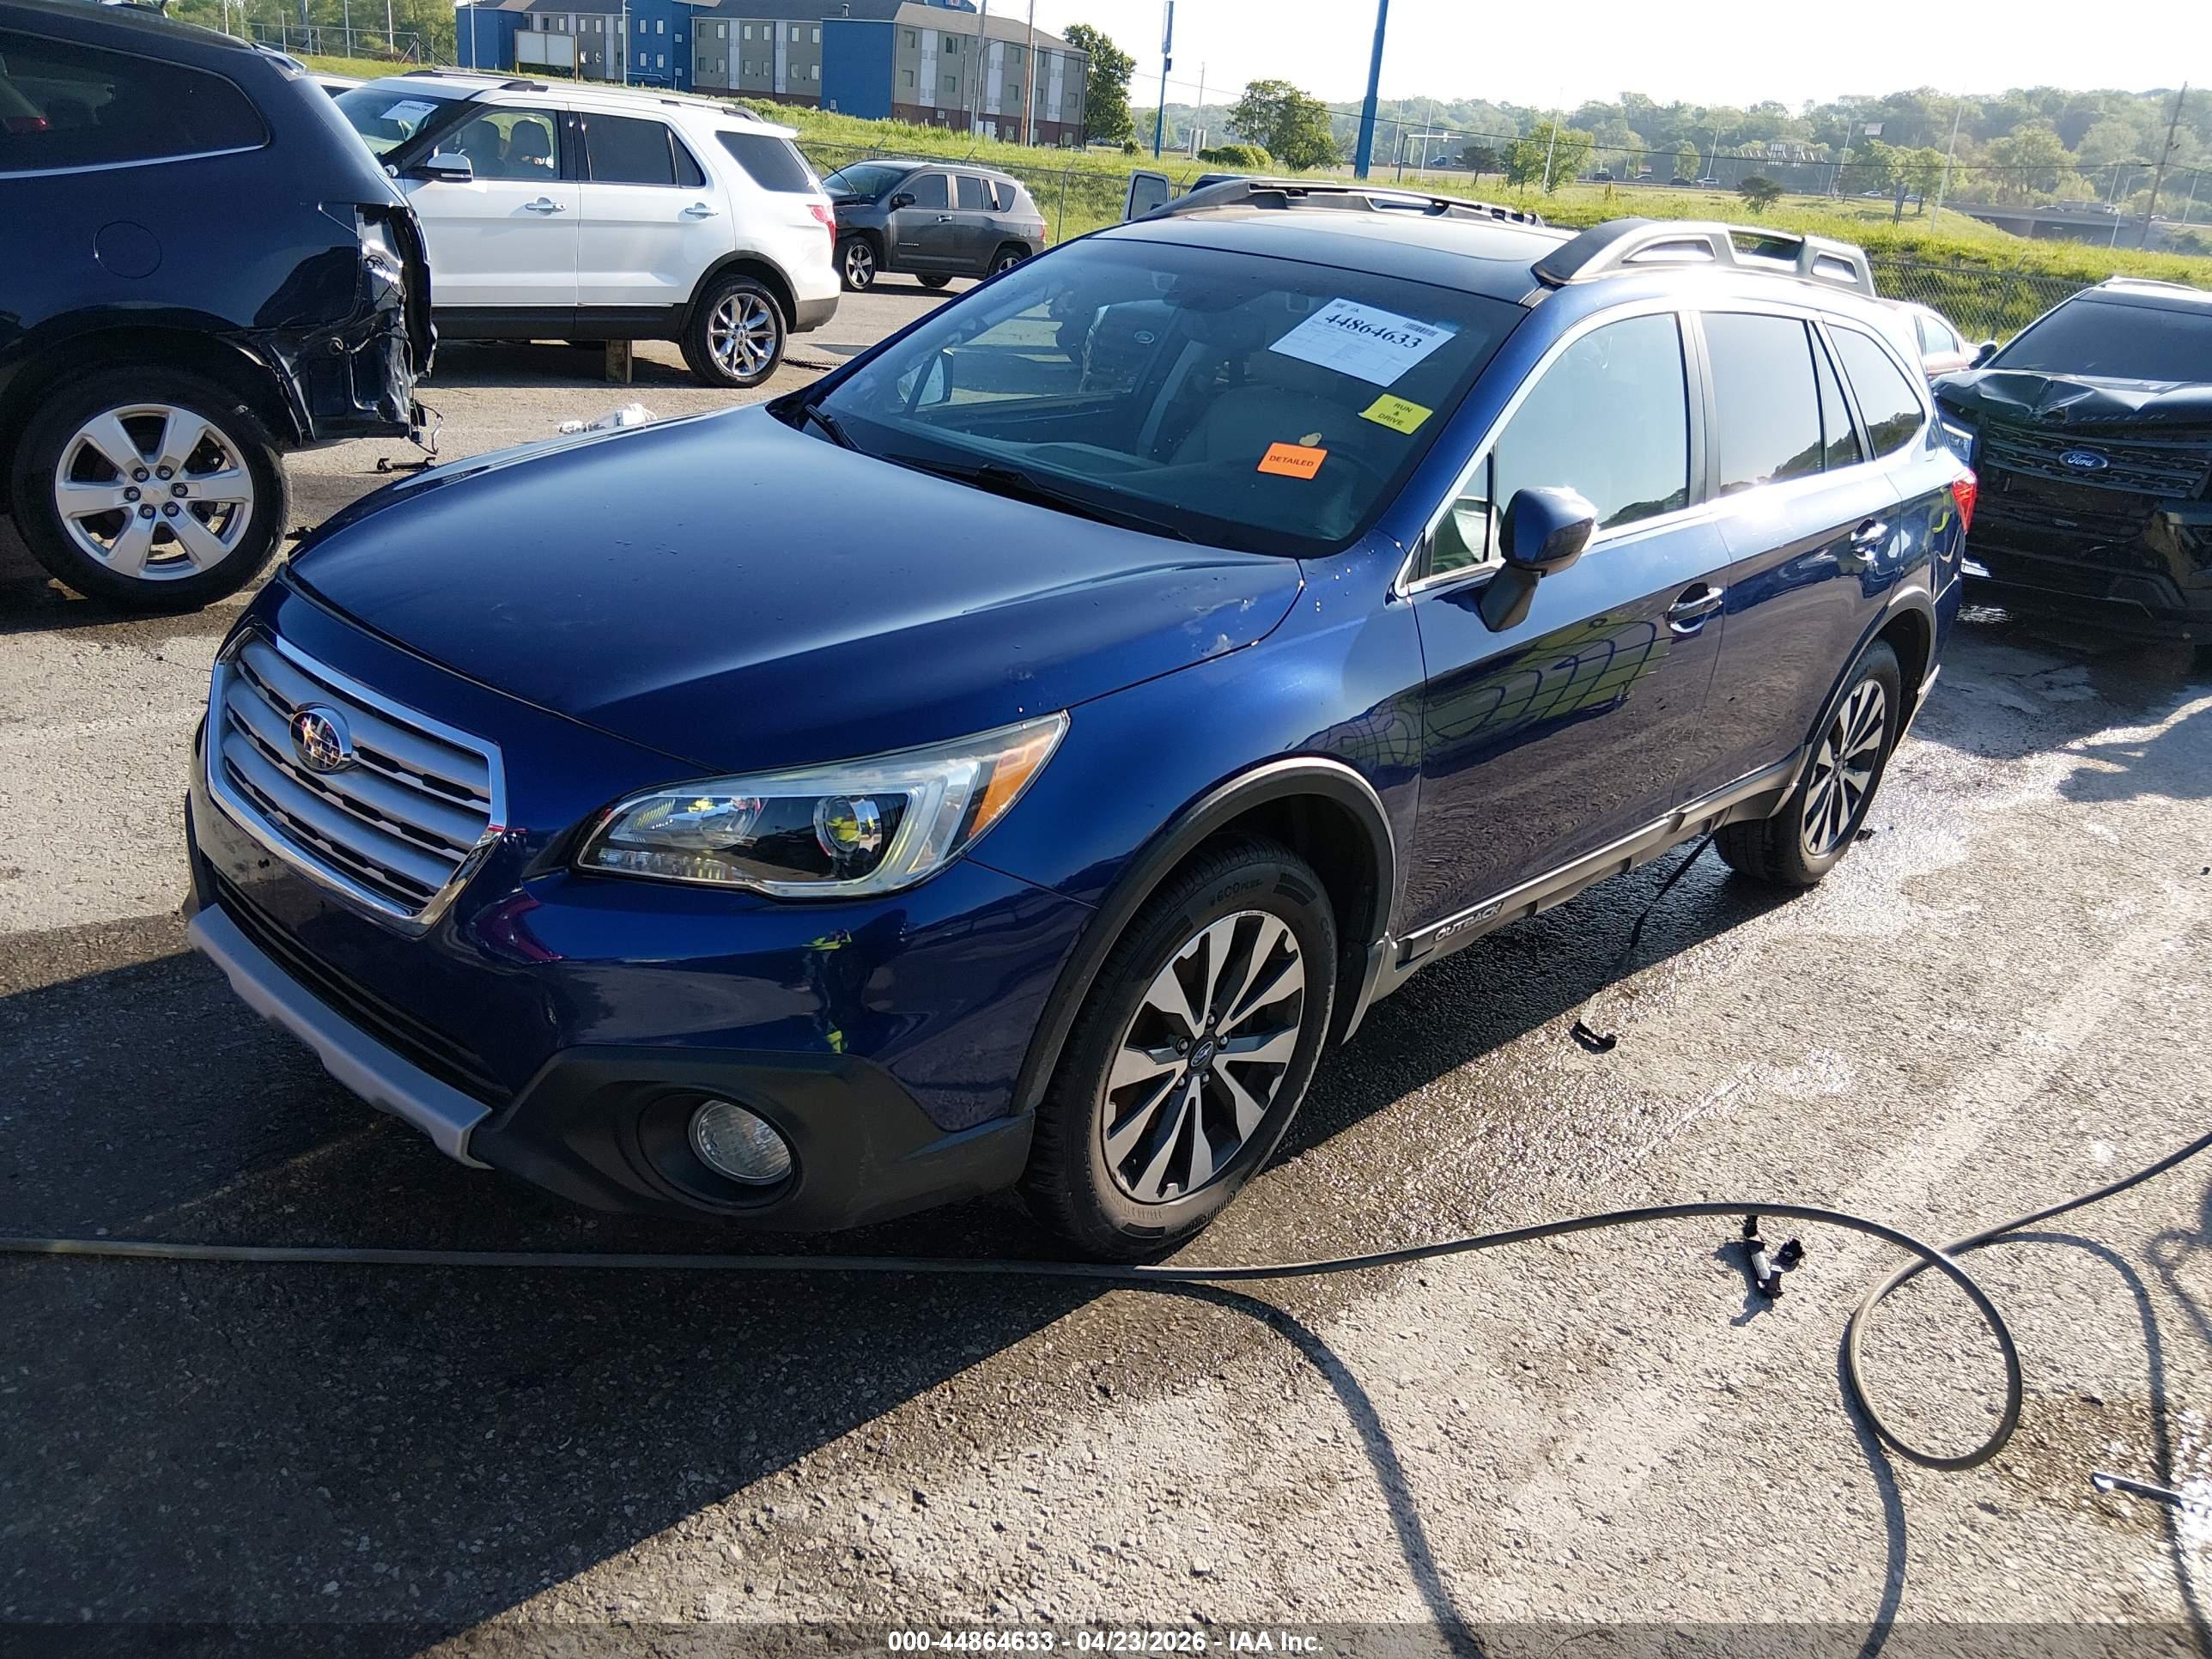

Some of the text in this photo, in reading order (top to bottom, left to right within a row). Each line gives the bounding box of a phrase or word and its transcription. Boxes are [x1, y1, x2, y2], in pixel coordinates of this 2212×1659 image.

[1324, 313, 1423, 349] 44864633
[1392, 402, 1413, 414] RUN
[1377, 412, 1405, 427] DRIVE
[1268, 454, 1316, 468] DETAILED
[2067, 453, 2095, 467] Ford
[1434, 902, 1502, 942] OUTBACK
